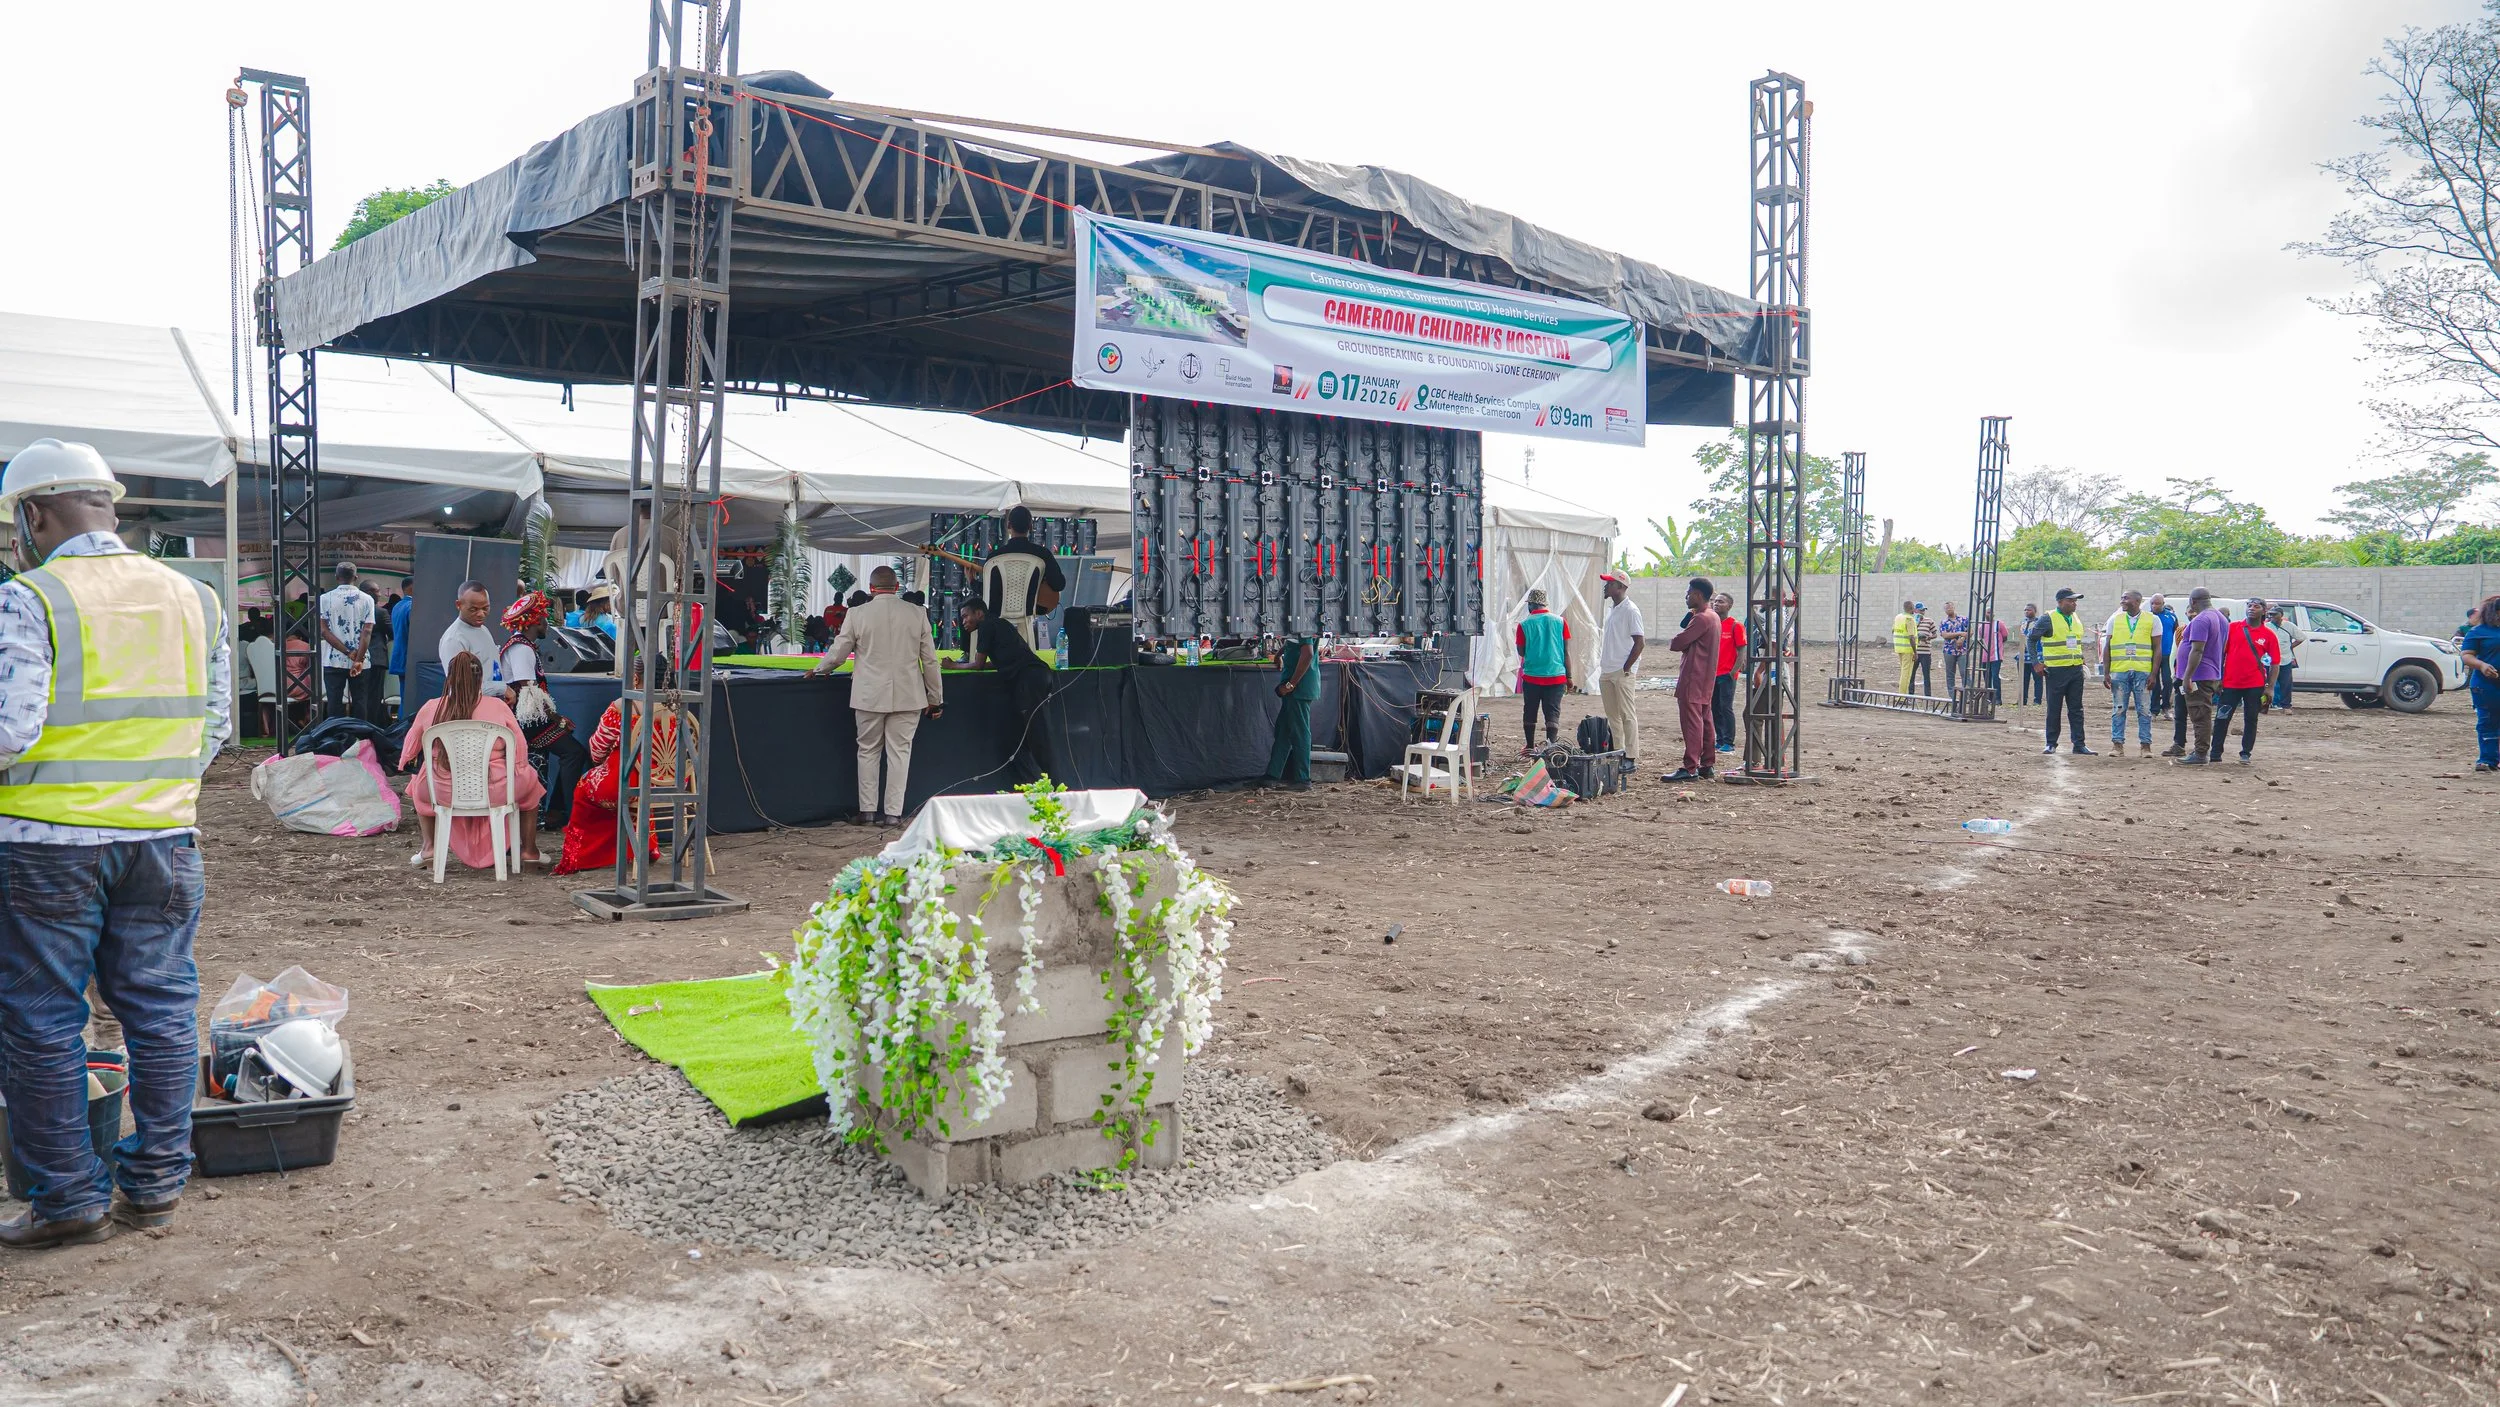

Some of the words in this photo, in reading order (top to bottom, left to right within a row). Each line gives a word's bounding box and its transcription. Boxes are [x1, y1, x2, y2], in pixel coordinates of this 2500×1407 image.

[1311, 272, 1367, 293] Cameroon
[1370, 281, 1405, 299] Baptist
[1407, 290, 1463, 309] Convention
[1465, 298, 1491, 317] (CBC)
[1492, 304, 1522, 320] Health
[1524, 310, 1559, 326] Services
[1324, 299, 1416, 336] CAMEROON
[1418, 314, 1503, 347] CHILDREN'S
[1506, 330, 1571, 360] HOSPITAL
[1337, 340, 1424, 363] GROUNDBREAKING
[1428, 353, 1436, 364] &
[1437, 355, 1494, 373] FOUNDATION
[1495, 363, 1521, 378] STONE
[1522, 367, 1561, 382] CEREMONY
[1341, 374, 1361, 401] 17
[1362, 375, 1400, 390] JANUARY
[1361, 388, 1397, 406] 2026
[1430, 387, 1448, 400] CBC
[1448, 389, 1473, 403] Health
[1475, 393, 1506, 407] Services
[1507, 396, 1541, 411] Complex
[1429, 400, 1475, 416] Mutengene
[1481, 405, 1521, 420] Cameroon
[1563, 407, 1592, 428] 9am
